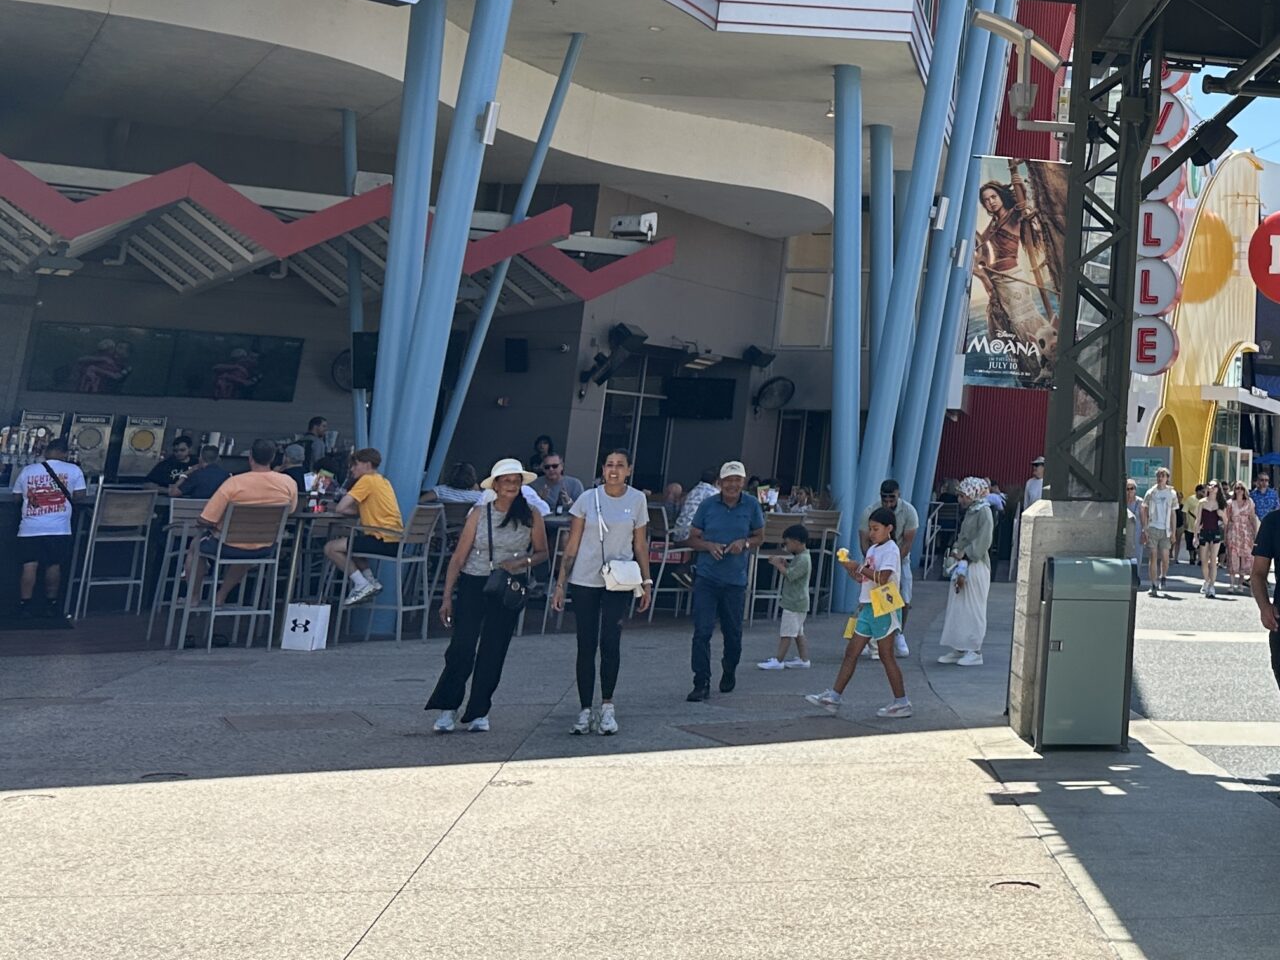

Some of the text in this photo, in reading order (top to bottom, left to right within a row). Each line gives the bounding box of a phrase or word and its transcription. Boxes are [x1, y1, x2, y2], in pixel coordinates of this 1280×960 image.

[967, 335, 1040, 357] MOANA
[988, 361, 1018, 370] JULY 10
